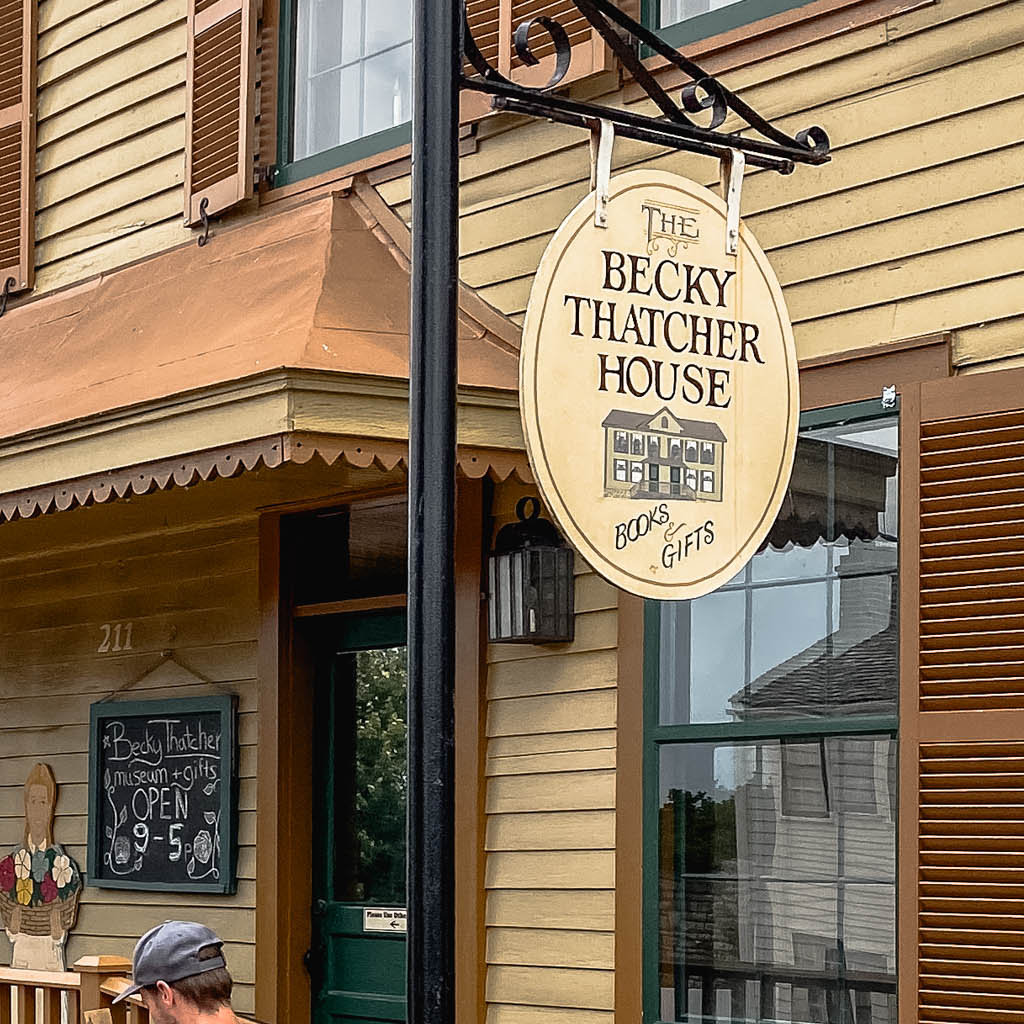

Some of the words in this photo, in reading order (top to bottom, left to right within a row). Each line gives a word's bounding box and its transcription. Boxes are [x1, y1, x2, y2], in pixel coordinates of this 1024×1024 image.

[641, 204, 700, 242] THE
[601, 250, 736, 307] BECKY
[564, 295, 766, 364] THATCHER
[597, 353, 732, 408] HOUSE
[615, 503, 670, 550] BOOKS
[662, 520, 715, 569] GIFTS
[98, 622, 133, 653] 211
[106, 721, 162, 767] Becky
[147, 720, 221, 753] Thatcher
[114, 767, 168, 787] museum
[132, 786, 188, 821] OPEN
